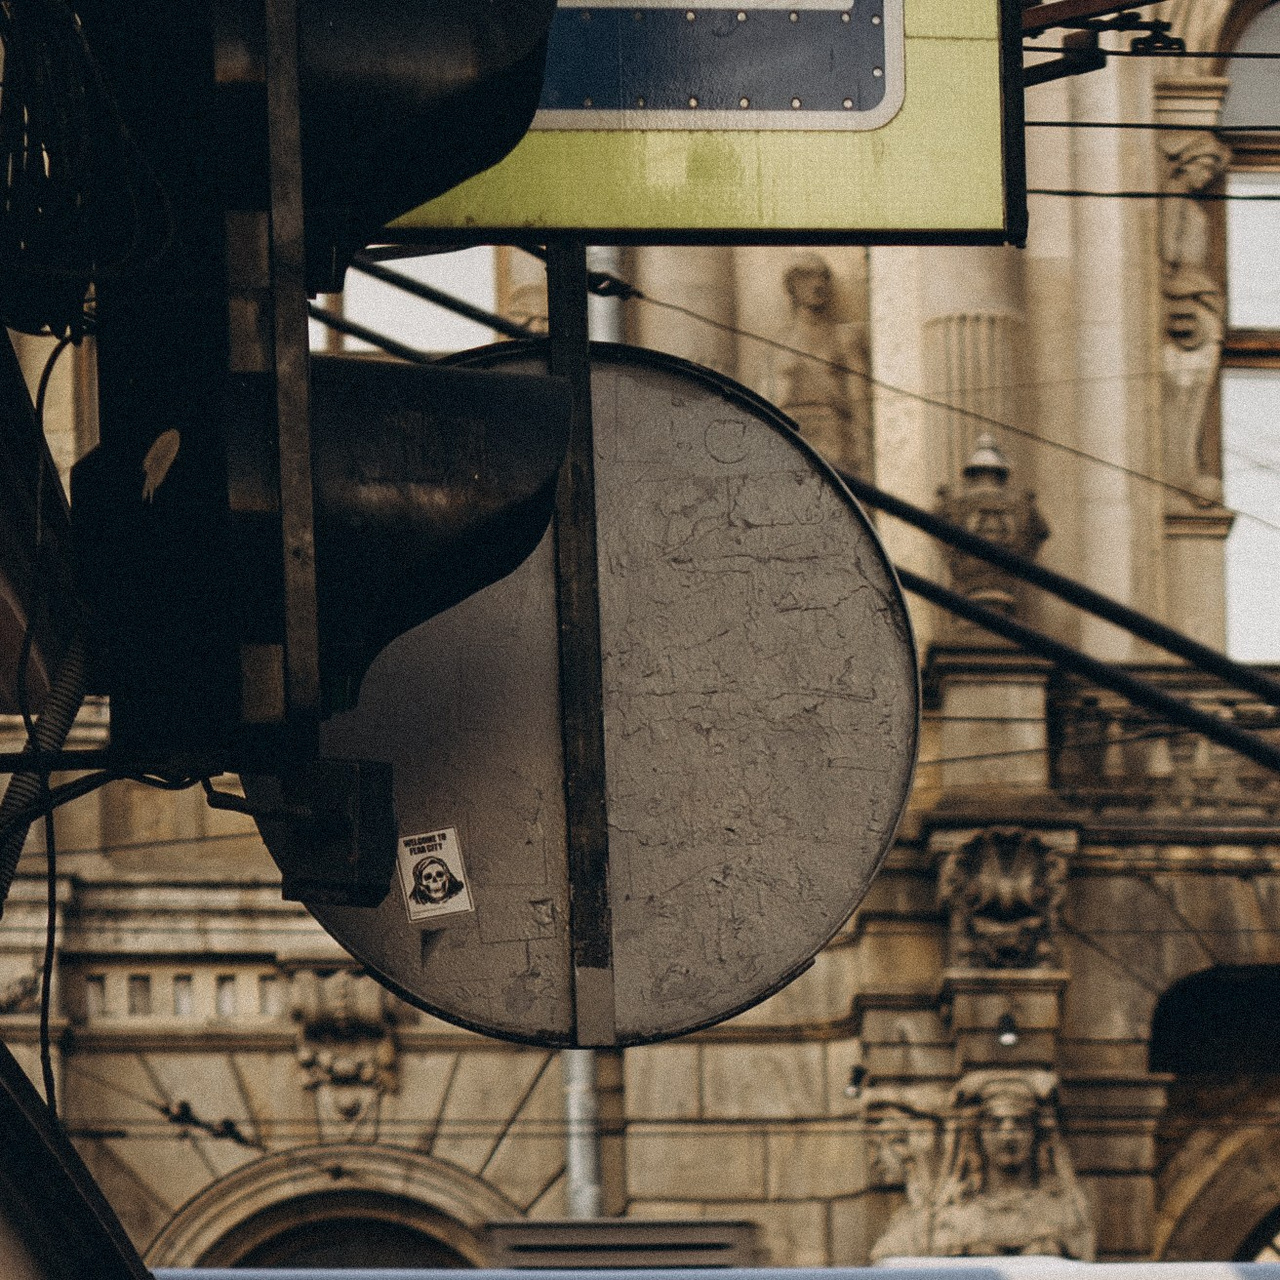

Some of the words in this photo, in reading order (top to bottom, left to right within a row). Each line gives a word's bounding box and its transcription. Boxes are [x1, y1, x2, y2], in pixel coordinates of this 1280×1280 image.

[403, 835, 436, 847] WELCOME
[437, 833, 446, 841] TO
[409, 845, 426, 856] FEAR
[426, 842, 443, 852] CITY
